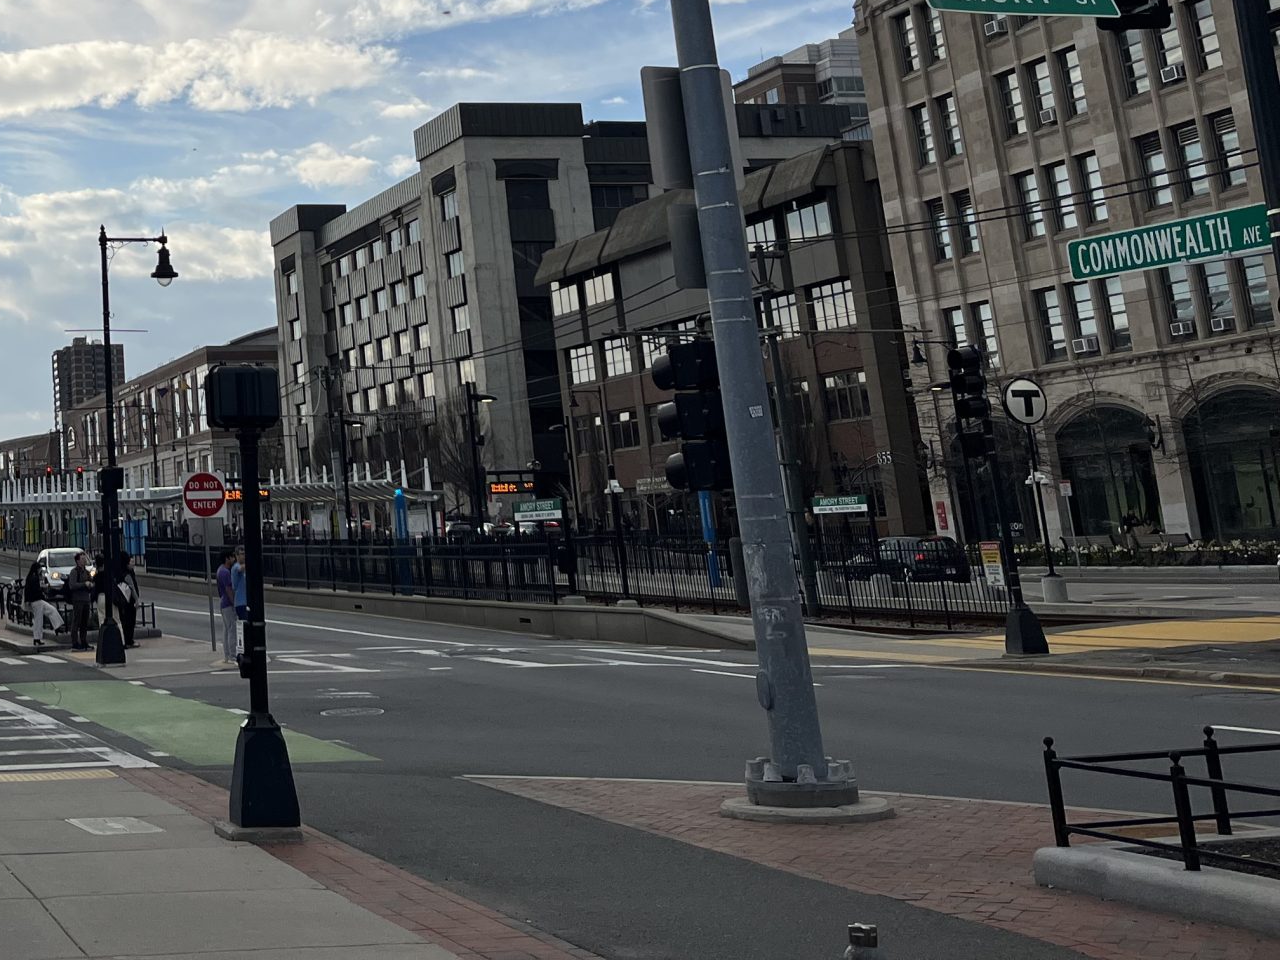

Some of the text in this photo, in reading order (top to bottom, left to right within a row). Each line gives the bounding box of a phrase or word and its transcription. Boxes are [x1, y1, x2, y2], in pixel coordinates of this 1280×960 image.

[1077, 216, 1263, 275] COMMONWEALTH AVE
[1010, 389, 1041, 418] T
[876, 451, 892, 465] 855
[188, 481, 218, 489] DO NOT
[192, 501, 217, 509] ENTER
[520, 500, 554, 512] AMORY STREET
[819, 496, 858, 506] AMORY STREET
